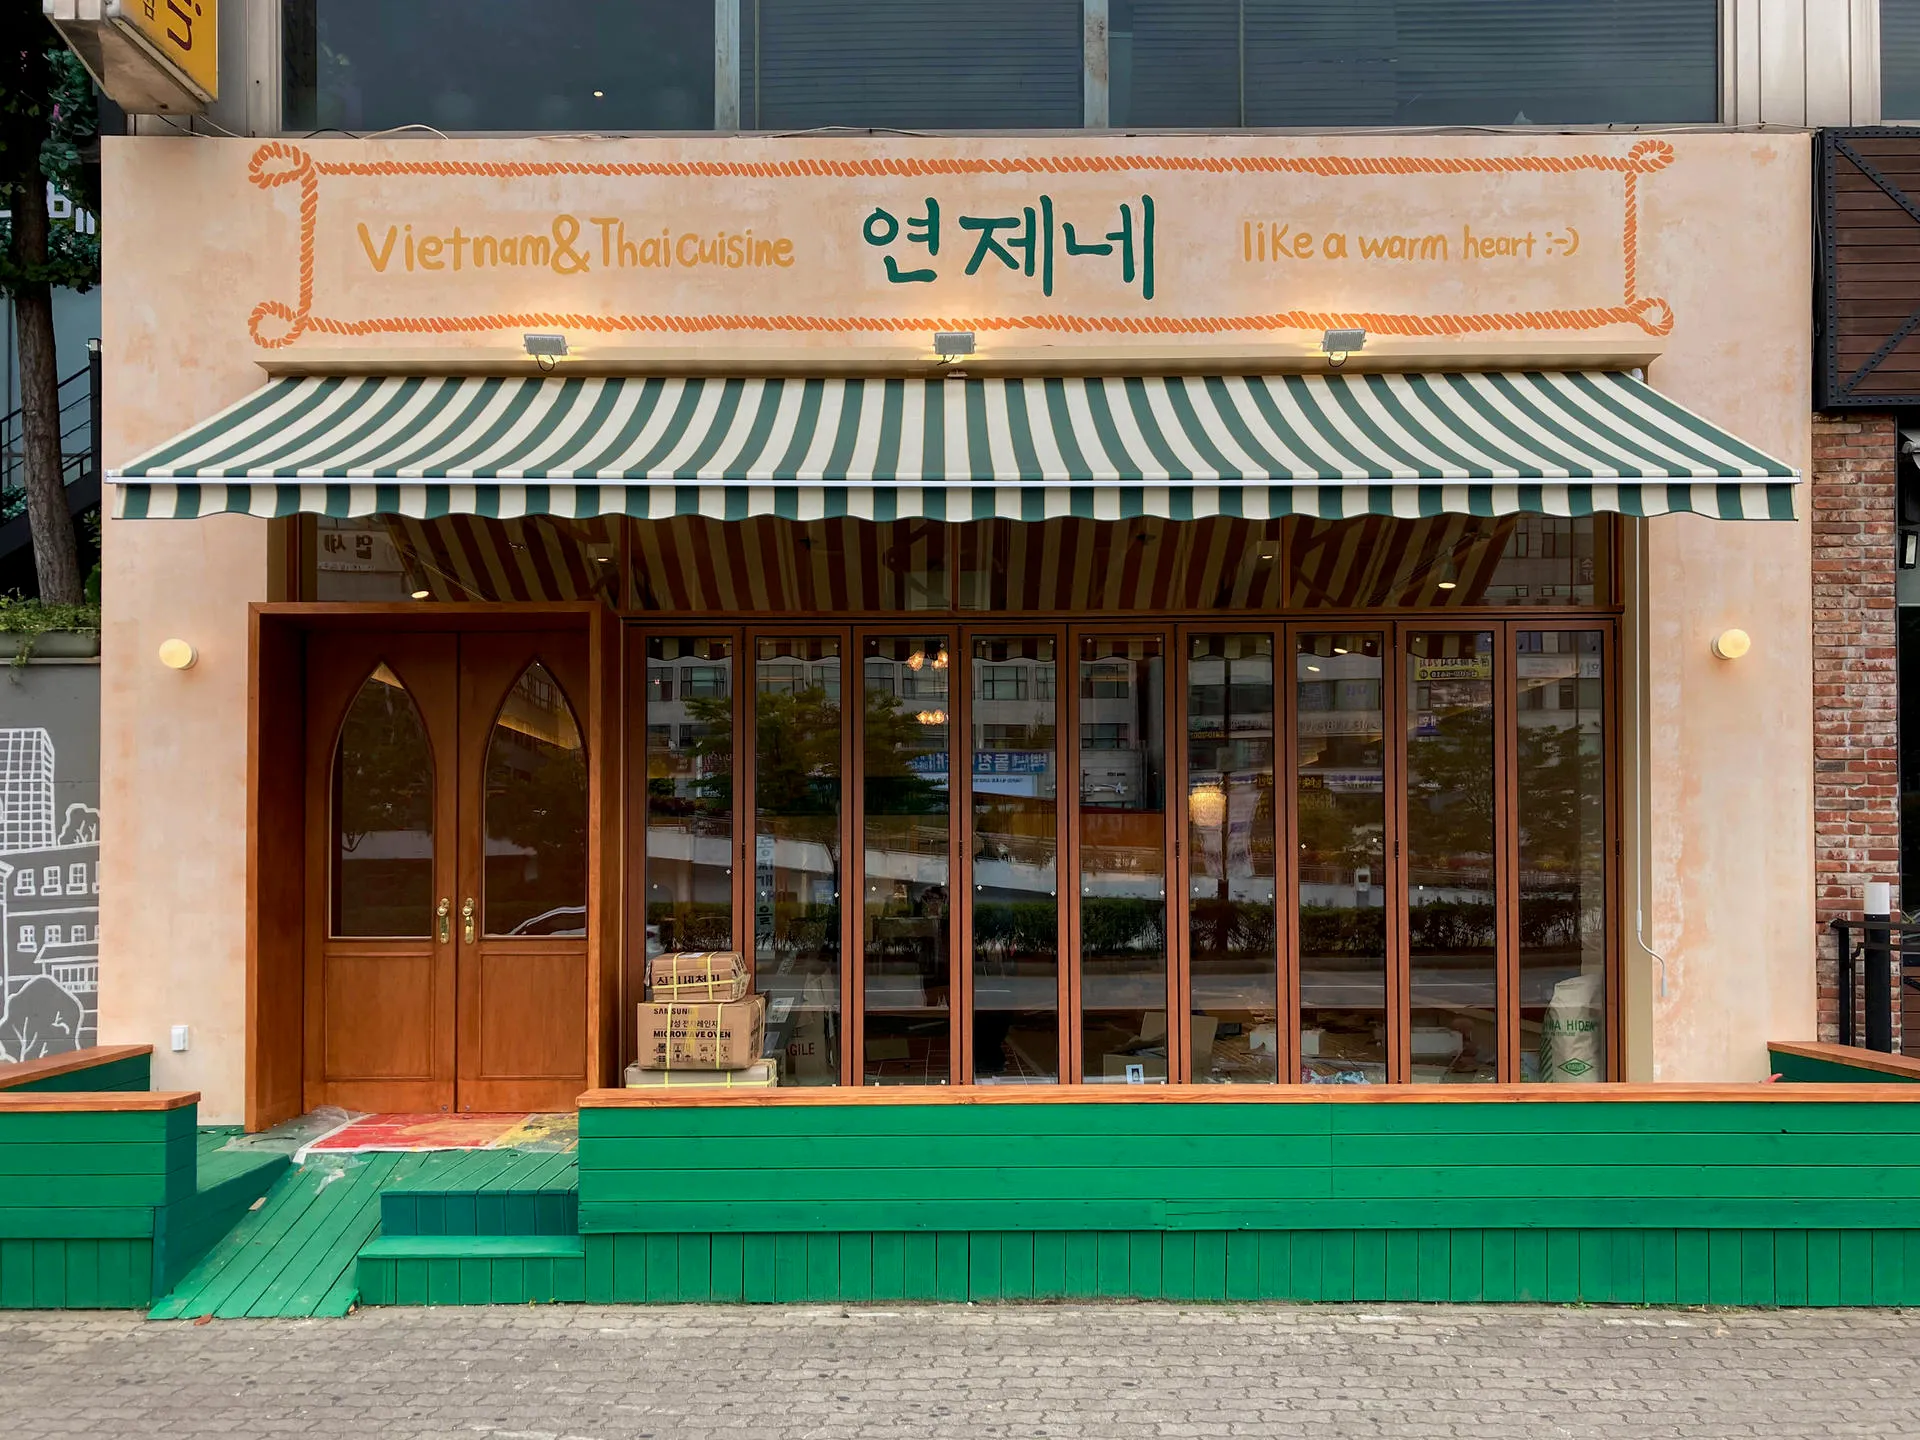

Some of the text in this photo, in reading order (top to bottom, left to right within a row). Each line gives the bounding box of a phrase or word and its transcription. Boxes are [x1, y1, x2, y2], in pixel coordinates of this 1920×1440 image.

[863, 195, 1155, 300] 연제네
[1323, 233, 1348, 260] a
[1358, 235, 1448, 261] warm
[1463, 224, 1536, 260] heart
[707, 1030, 731, 1038] OVEN
